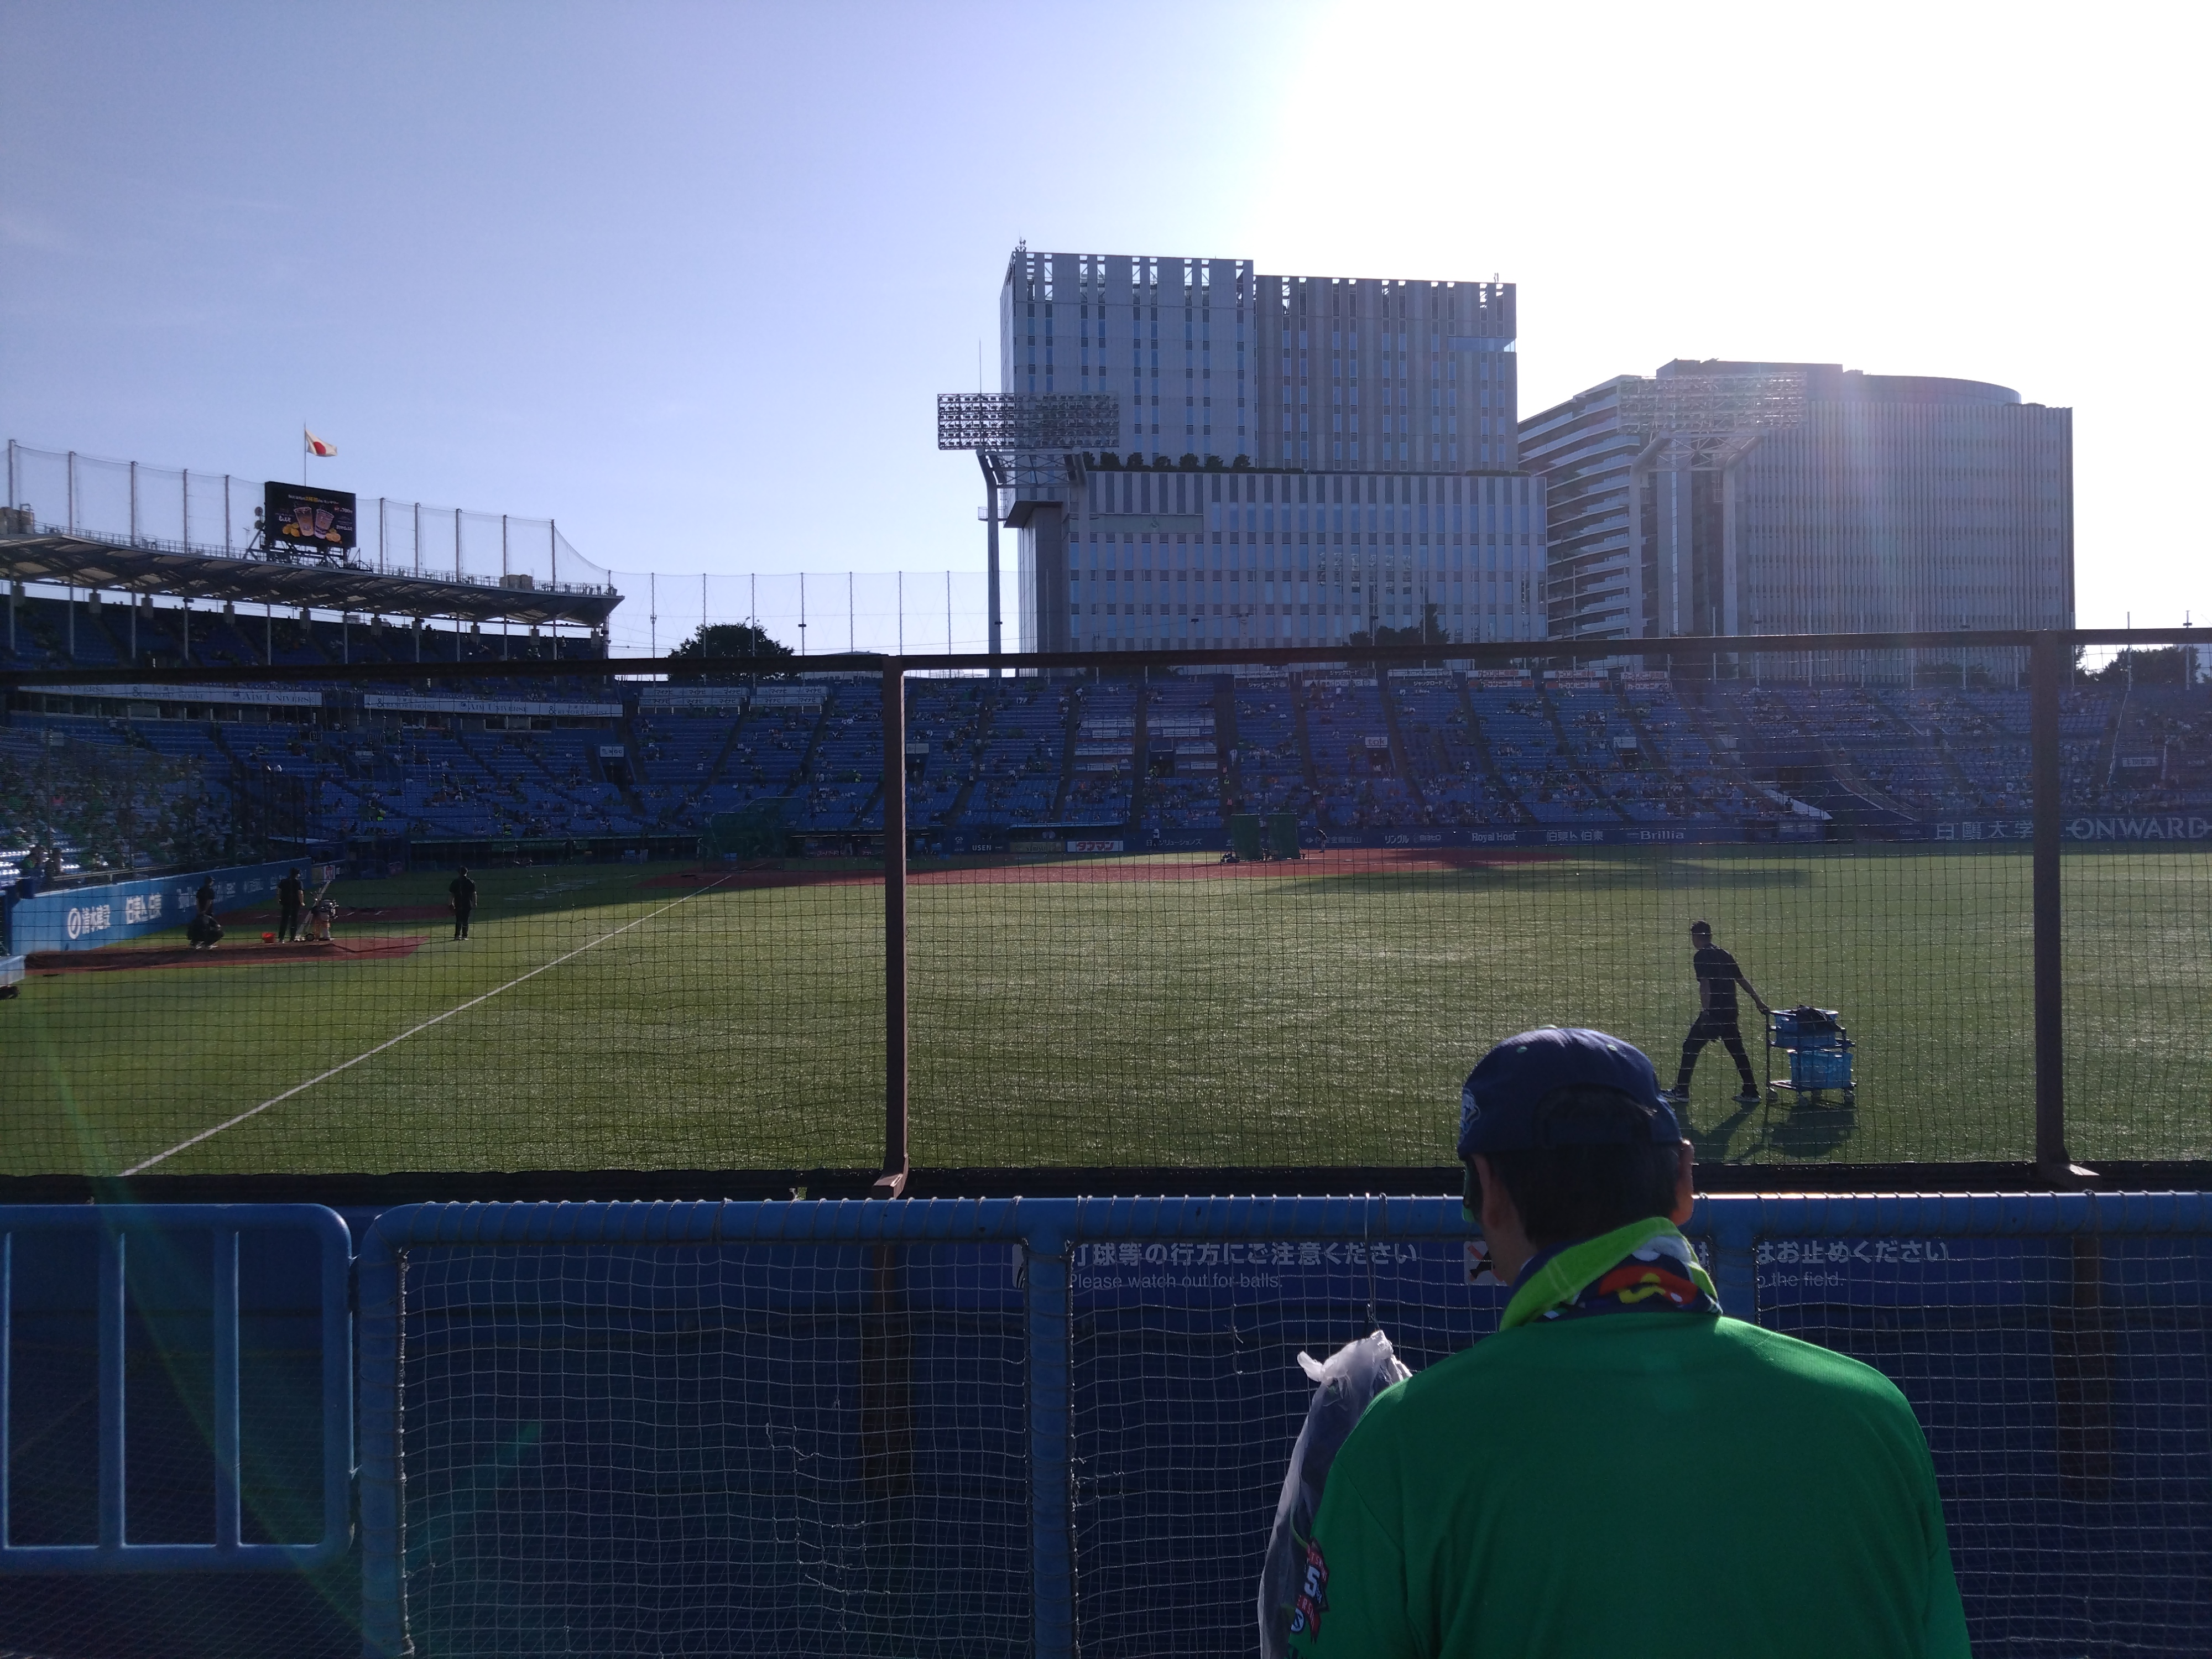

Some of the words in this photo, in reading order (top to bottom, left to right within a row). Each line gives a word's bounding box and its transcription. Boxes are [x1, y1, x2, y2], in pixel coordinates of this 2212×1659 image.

[2065, 817, 2212, 841] ONWARD
[1385, 834, 1410, 844] リングル
[1472, 832, 1495, 843] Royal
[1496, 832, 1516, 841] Host
[1547, 831, 1568, 842] 伯東
[1580, 830, 1604, 841] 伯東
[1640, 831, 1685, 840] Brillia
[1076, 841, 1114, 852] タフマン
[1146, 838, 1203, 847] 日ソリューションズ
[1071, 1274, 1122, 1289] Please
[1128, 1274, 1176, 1289] watch
[1181, 1274, 1208, 1289] out
[1213, 1273, 1235, 1288] for
[1240, 1273, 1283, 1288] balls.
[1771, 1271, 1798, 1287] the
[1803, 1271, 1844, 1287] field.
